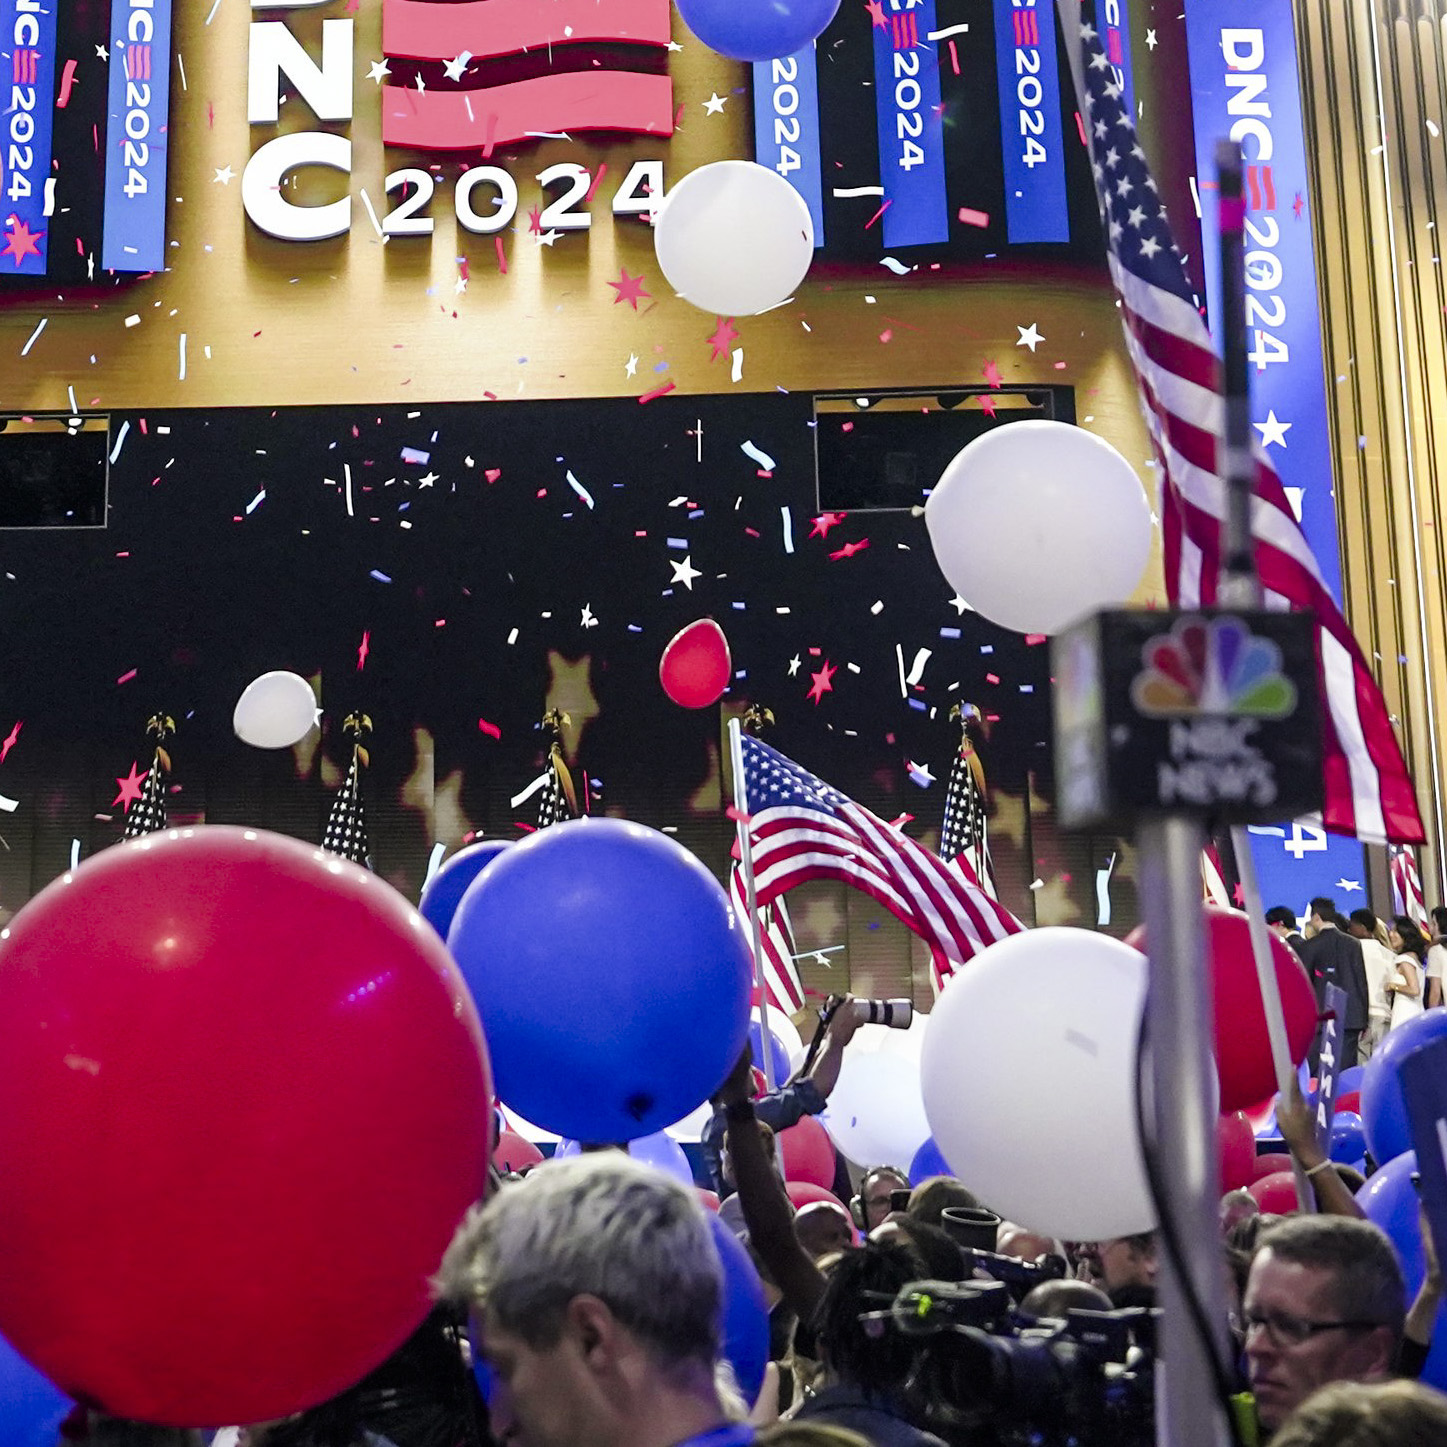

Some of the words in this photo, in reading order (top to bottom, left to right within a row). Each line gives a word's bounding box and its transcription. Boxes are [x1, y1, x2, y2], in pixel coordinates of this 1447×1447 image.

[7, 85, 38, 202] 2024
[122, 83, 152, 200] 2024
[771, 56, 804, 177] 2024
[892, 51, 926, 171] 2024
[1014, 48, 1048, 169] 2024
[382, 161, 666, 236] 2024
